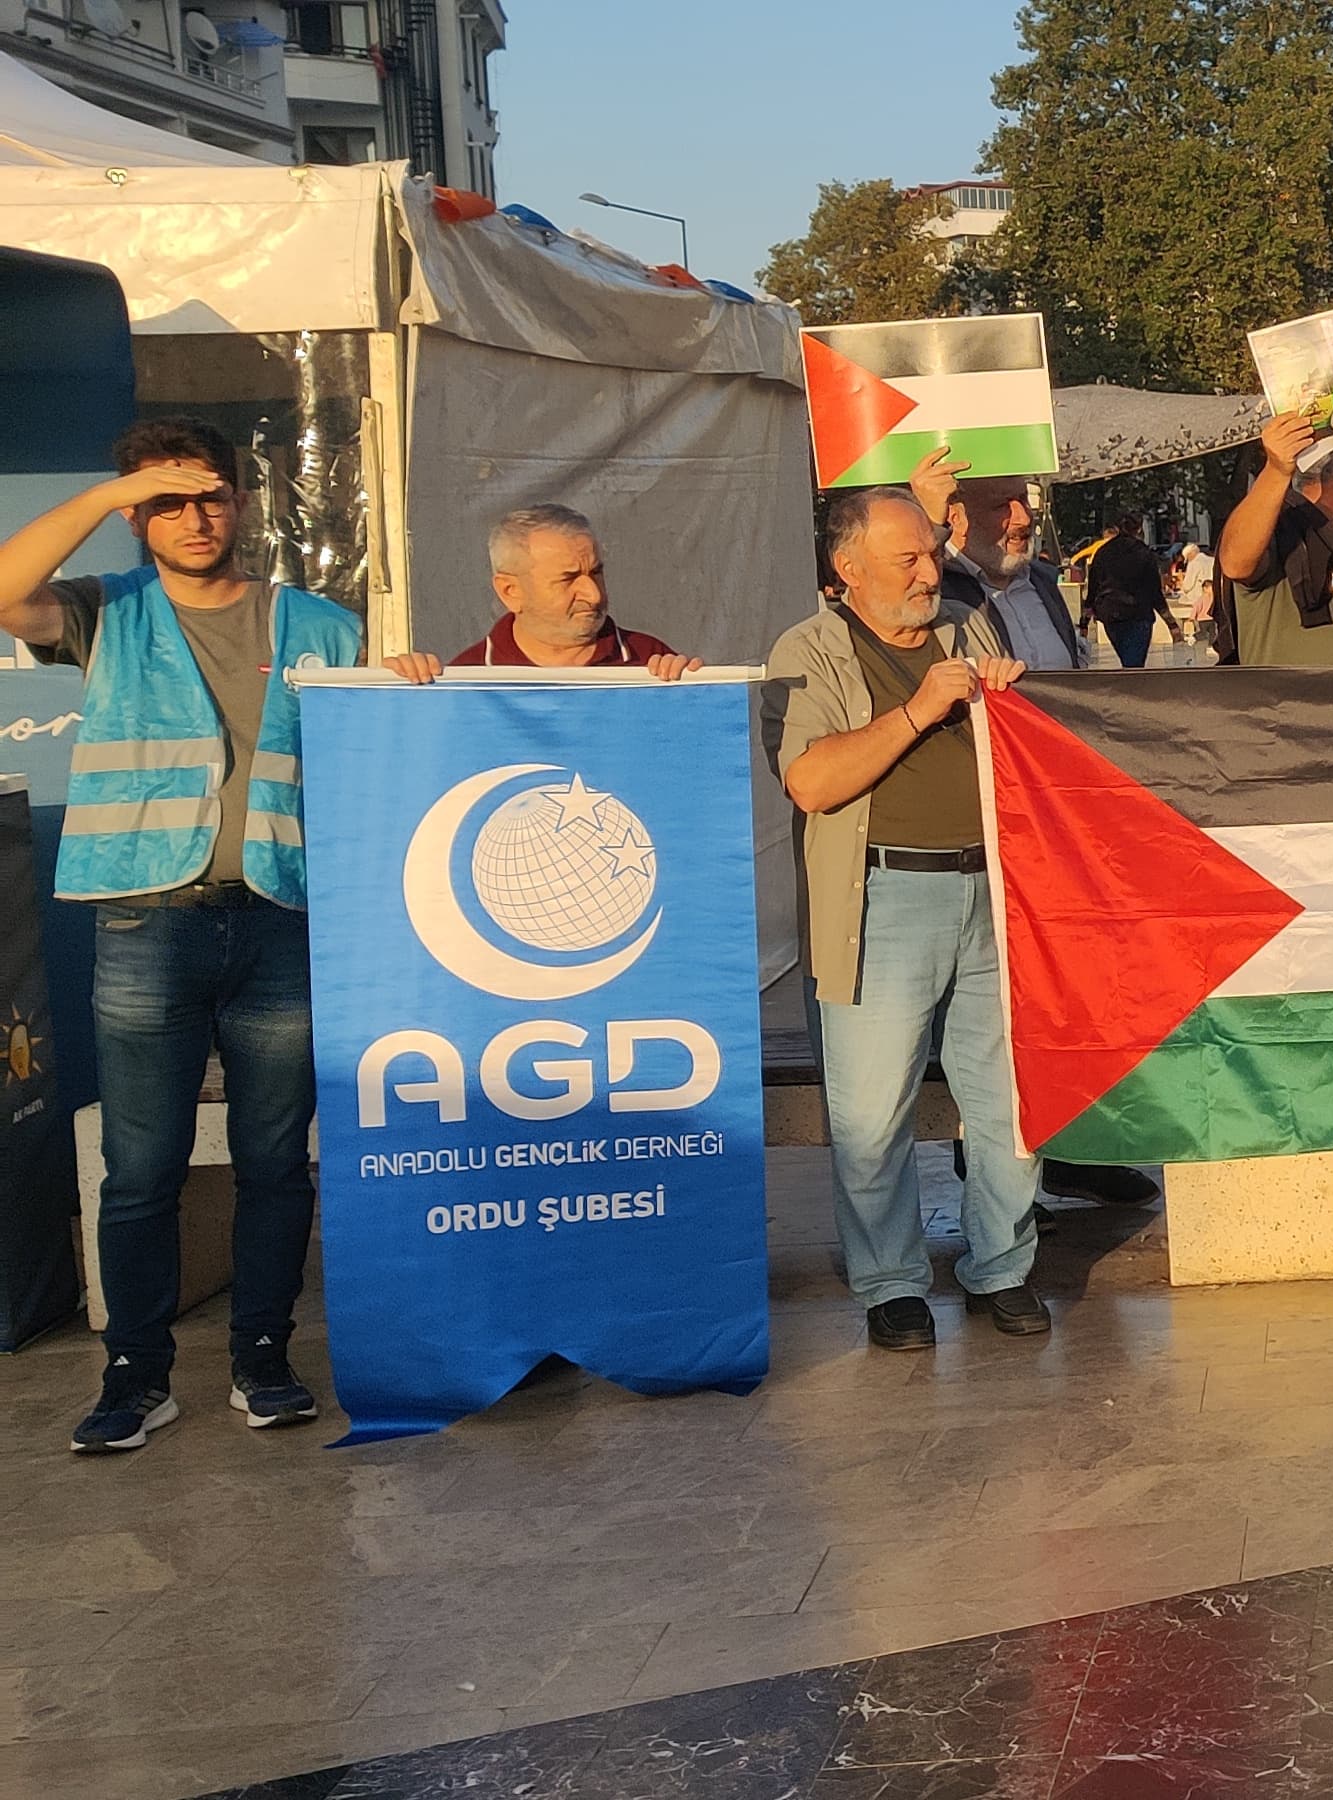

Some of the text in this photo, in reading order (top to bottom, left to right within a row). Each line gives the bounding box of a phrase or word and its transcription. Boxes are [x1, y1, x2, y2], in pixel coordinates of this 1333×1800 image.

[357, 1019, 721, 1128] AGD
[360, 1130, 724, 1178] ANADOLU GENÇLİK DERNEĞİ
[426, 1184, 665, 1235] ORDU ŞUBESİ
